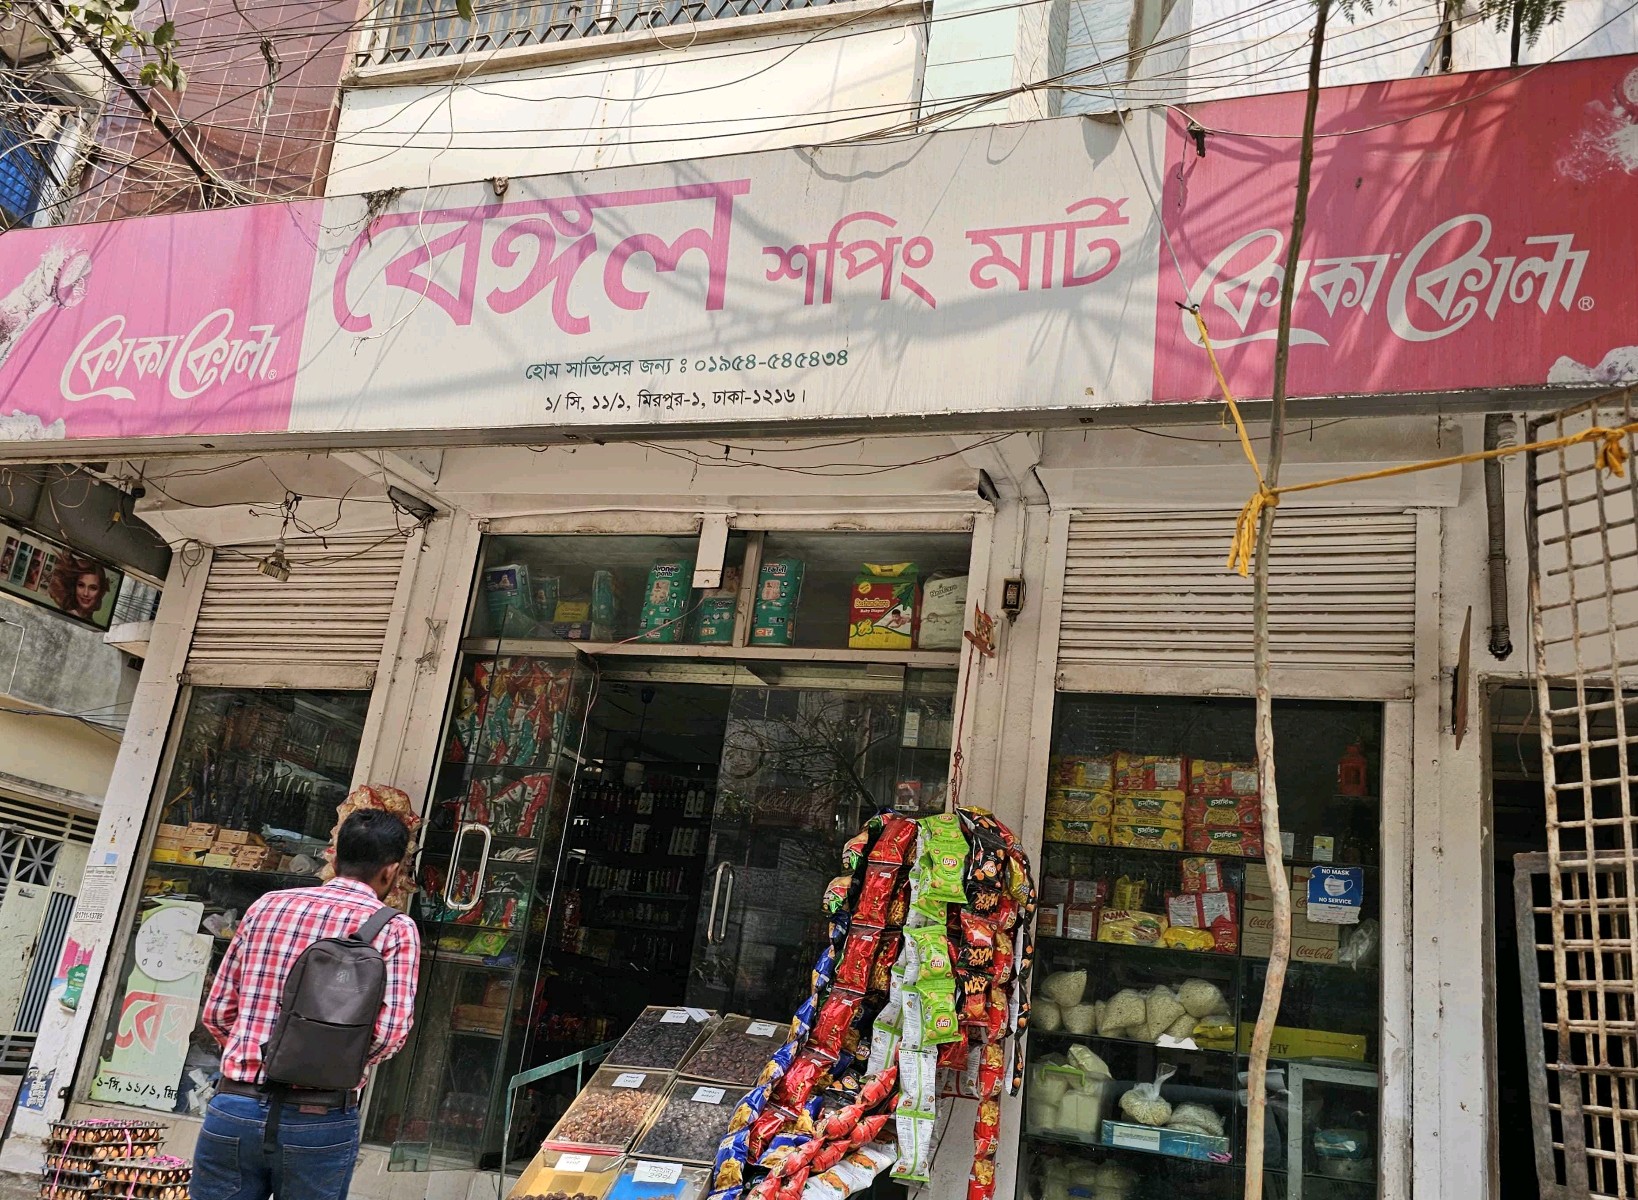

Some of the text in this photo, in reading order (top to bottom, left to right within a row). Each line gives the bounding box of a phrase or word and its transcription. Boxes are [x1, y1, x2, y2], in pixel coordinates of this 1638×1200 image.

[332, 178, 1130, 335] বেঙ্গল শপিং মার্ট
[526, 361, 561, 381] হোম
[565, 355, 635, 378] সার্ভিসের
[639, 358, 674, 375] জন্য
[694, 350, 848, 373] ০১৯৫৪-৫৪৫৪৩৪
[637, 389, 706, 411] মিরপুর-১,
[1102, 910, 1130, 922] MAMA
